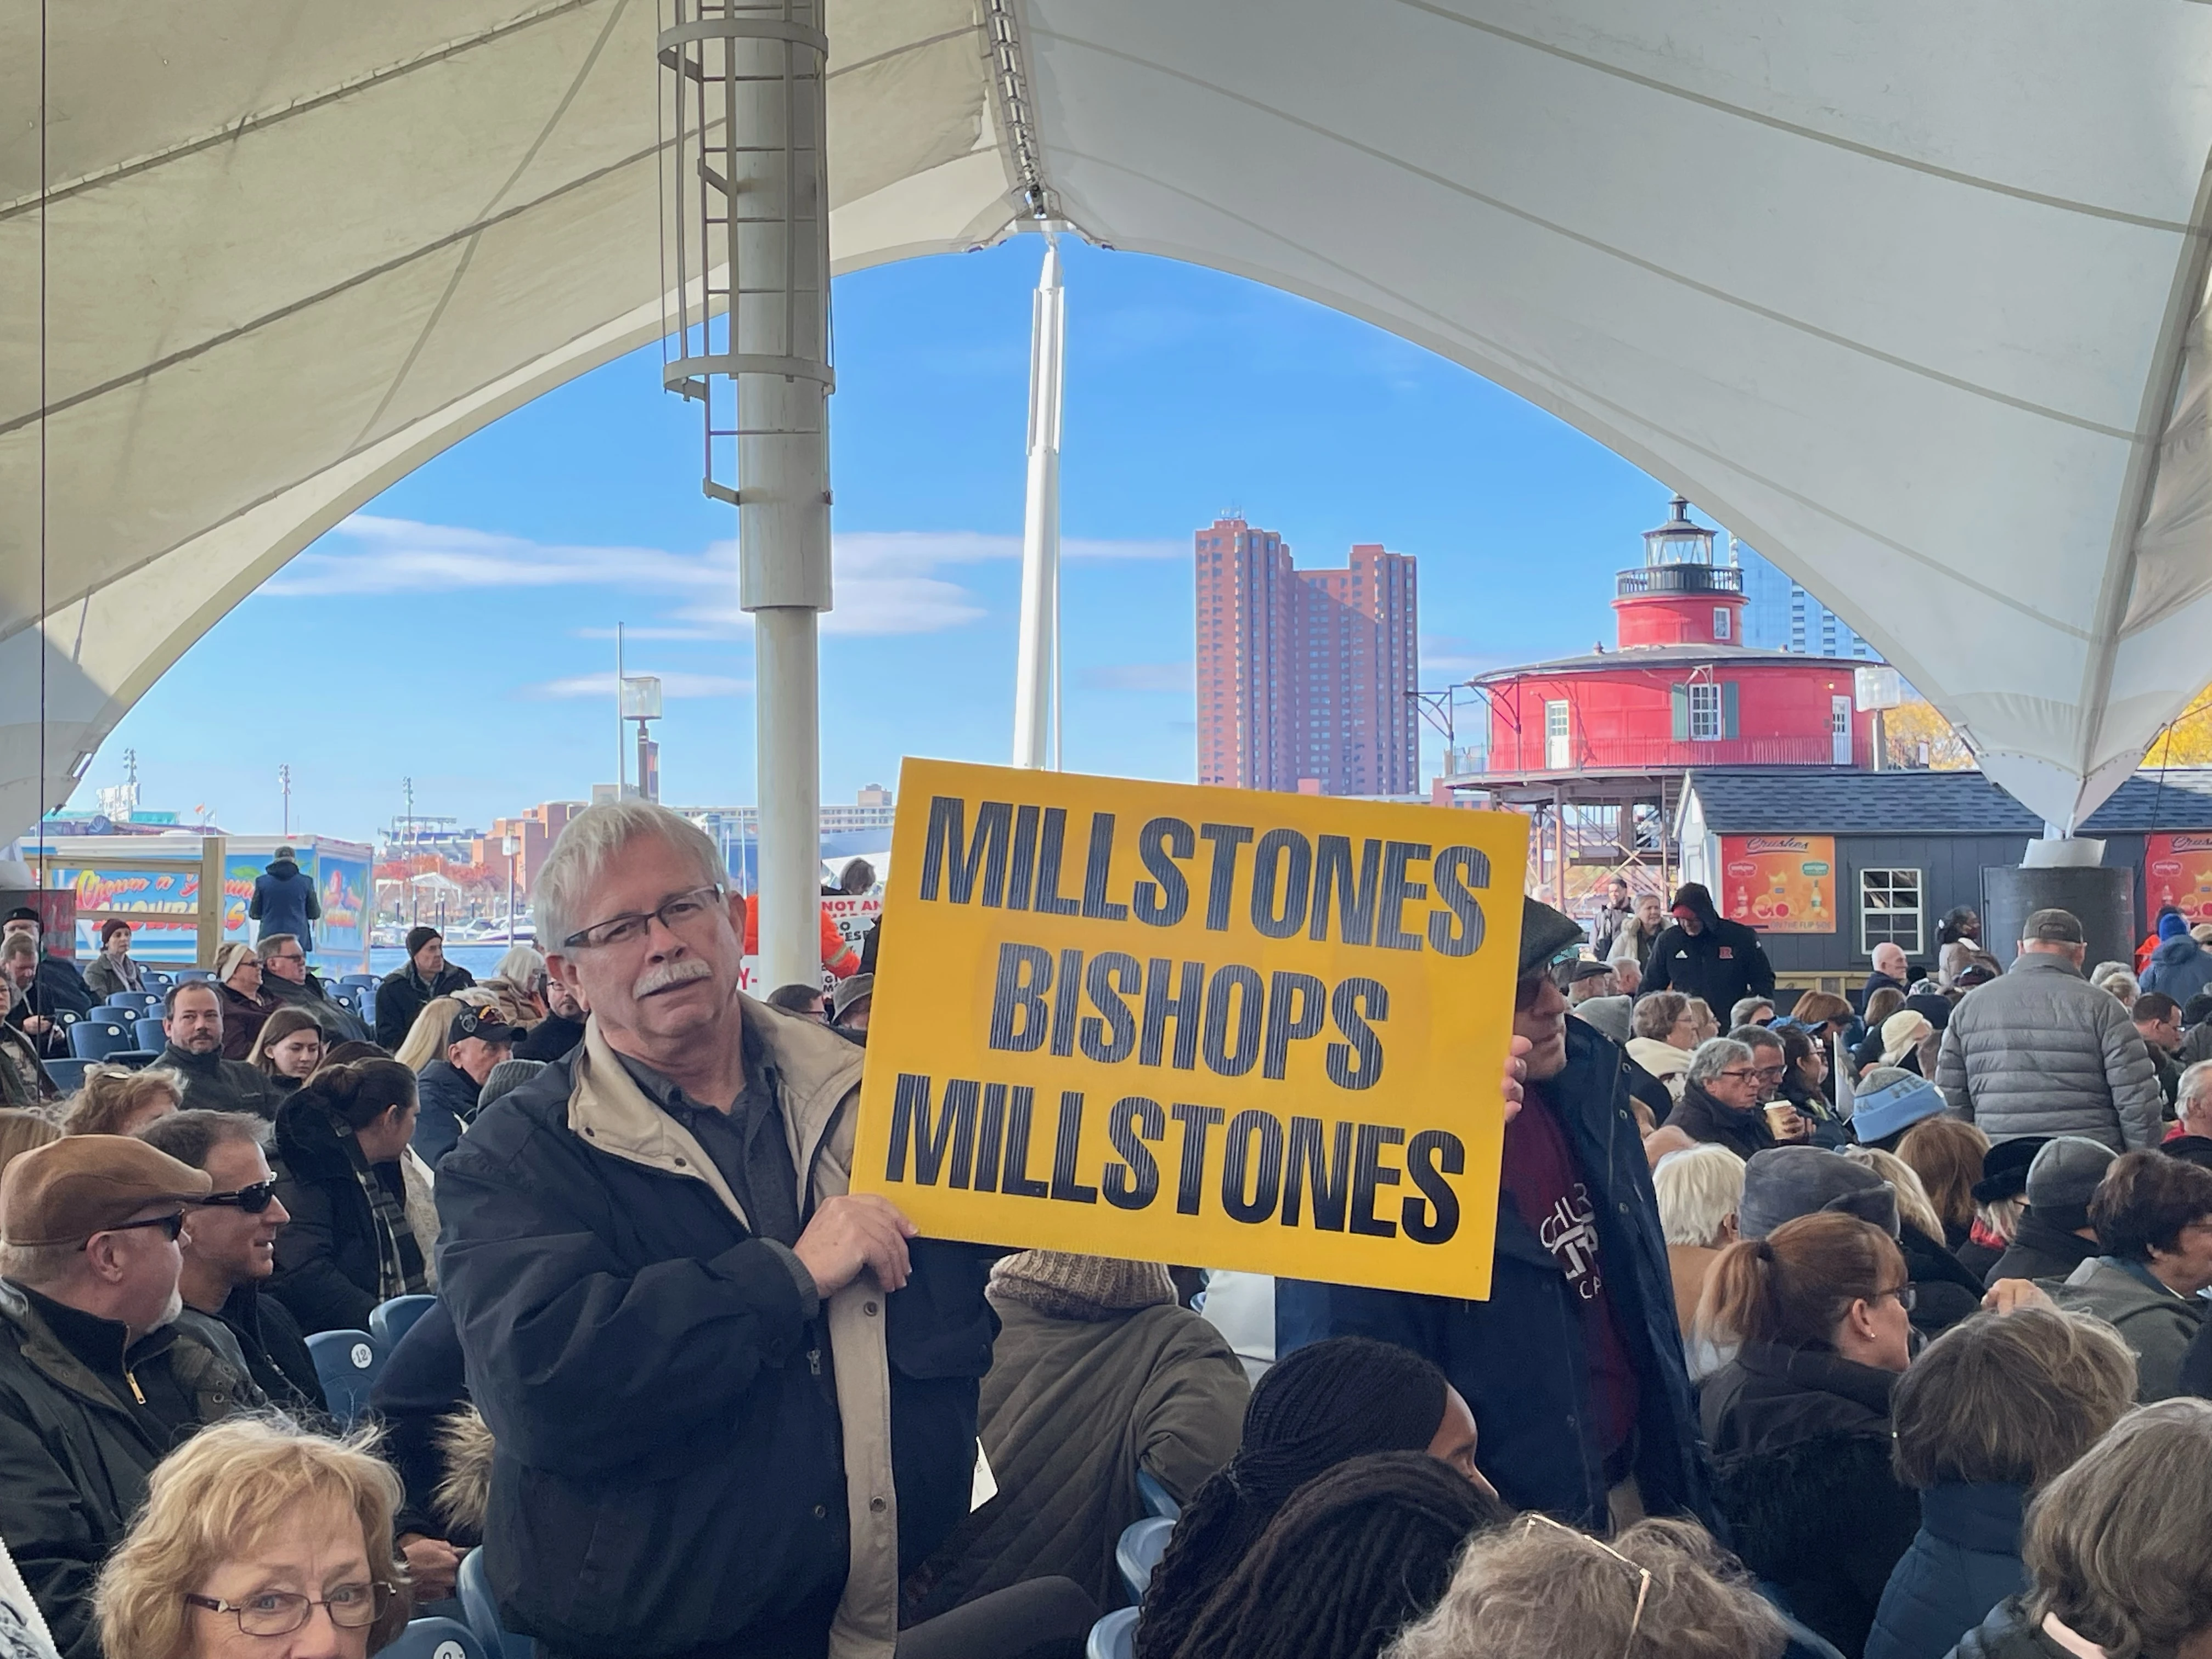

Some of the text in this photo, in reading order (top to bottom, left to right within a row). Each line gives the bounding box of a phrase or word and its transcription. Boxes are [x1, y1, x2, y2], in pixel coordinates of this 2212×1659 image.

[821, 901, 855, 911] NOT
[920, 795, 1491, 957] MILLSTONES
[990, 942, 1389, 1091] BISHOPS
[885, 1073, 1465, 1245] MILLSTONES
[356, 1348, 368, 1363] 12
